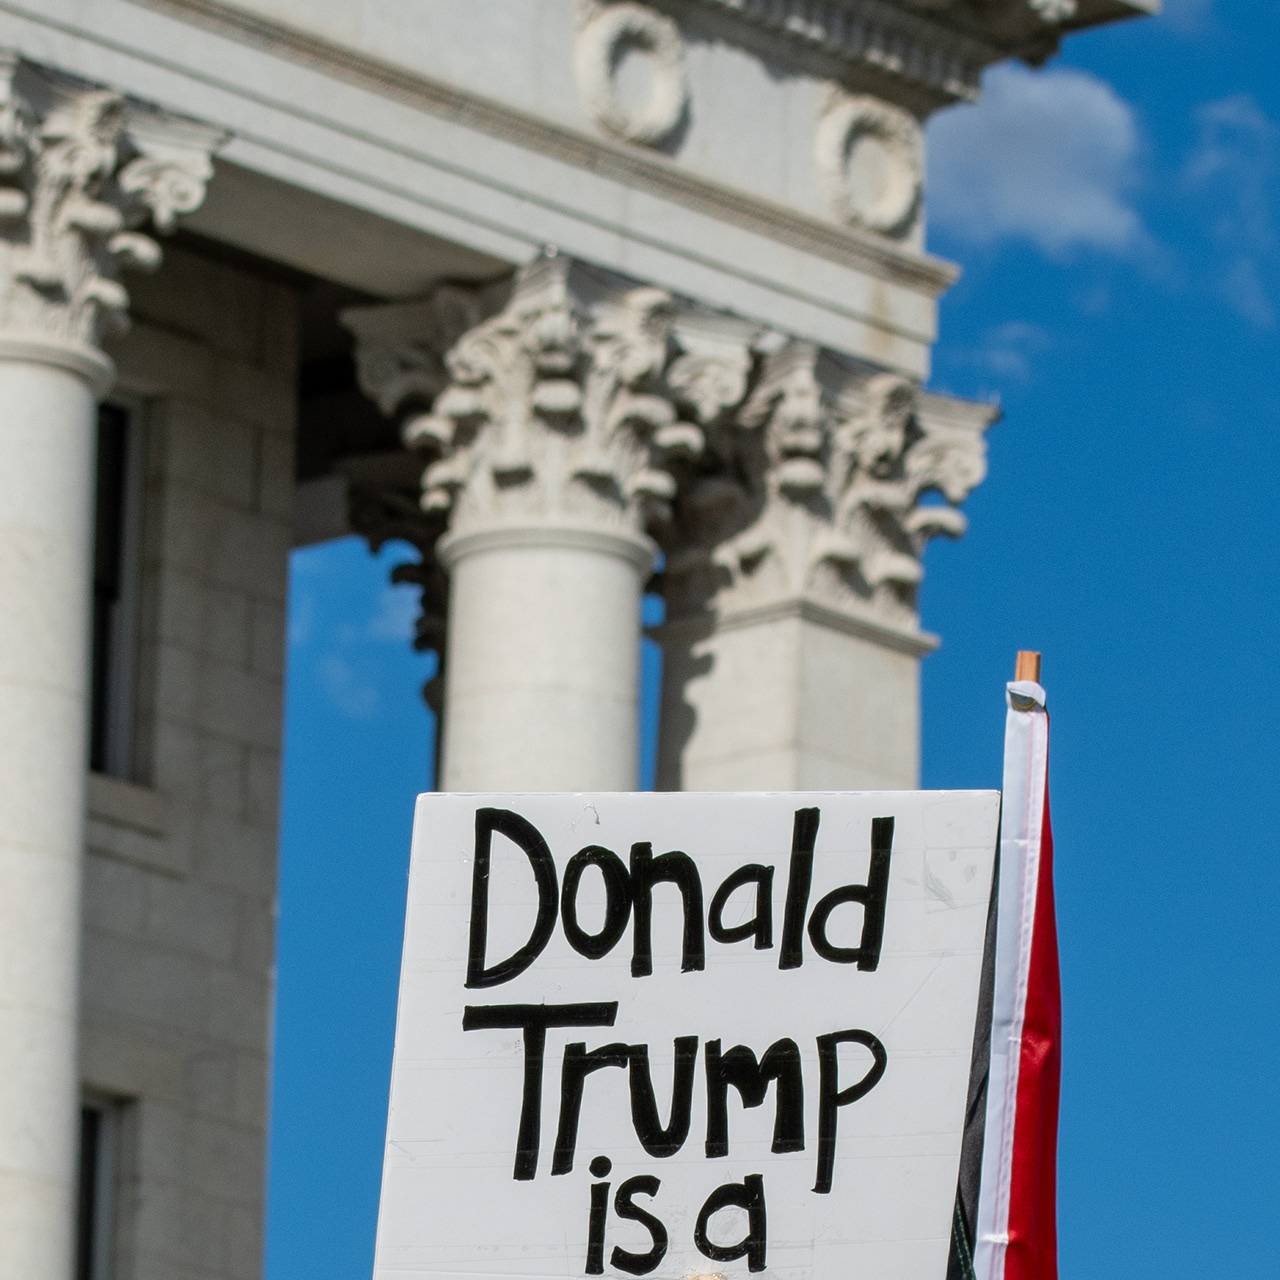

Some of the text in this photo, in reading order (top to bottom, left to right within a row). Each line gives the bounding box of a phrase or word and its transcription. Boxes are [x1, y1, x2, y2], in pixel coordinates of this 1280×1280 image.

[464, 806, 895, 989] Donald
[462, 1001, 888, 1194] Trump
[585, 1155, 767, 1275] is a
